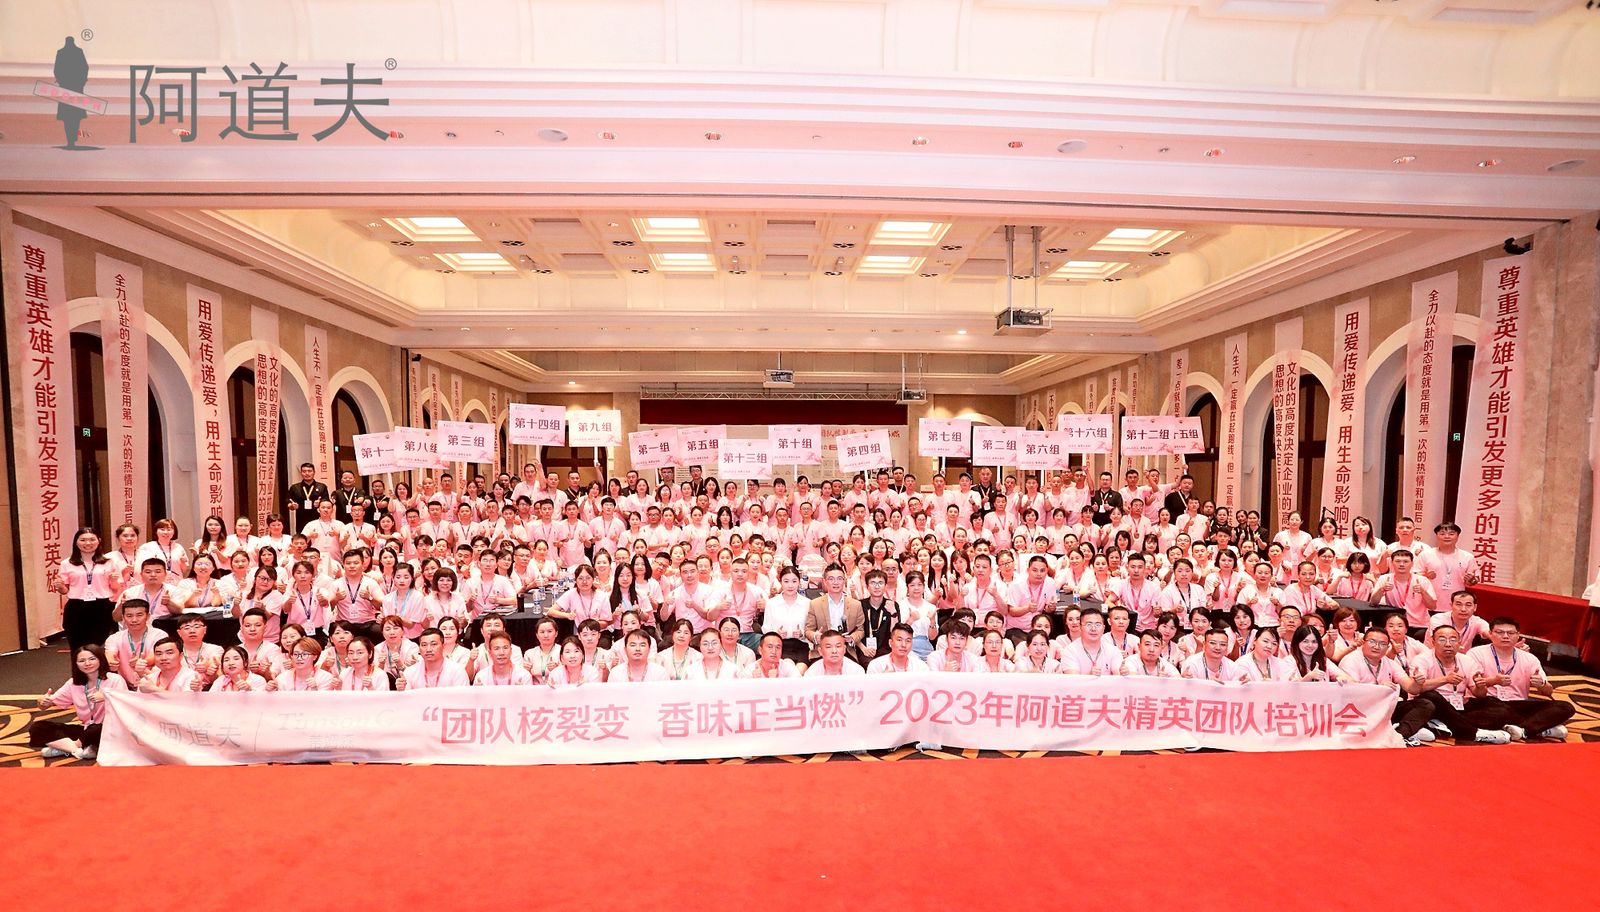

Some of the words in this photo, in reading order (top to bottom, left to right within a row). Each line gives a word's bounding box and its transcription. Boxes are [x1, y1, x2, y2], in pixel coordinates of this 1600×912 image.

[1414, 289, 1439, 541] 全力以赴的态度就是用第一次的热情和最后一
[514, 417, 560, 431] 第十四组
[578, 422, 612, 433] 第九组
[447, 434, 485, 447] 第三组
[928, 431, 962, 442] 第七组
[1126, 429, 1170, 440] 第十二组
[638, 441, 670, 455] 第一组
[687, 439, 718, 452] 第五组
[778, 438, 812, 449] 第十组
[847, 443, 881, 457] 第四组
[982, 440, 1016, 451] 第二组
[1026, 444, 1060, 455] 第六组
[1281, 361, 1297, 530] 文化的高度决定企业的高
[723, 453, 767, 464] 第十三组
[880, 689, 1367, 738] 2023年阿道夫精英团队培训会
[158, 720, 242, 749] 阿道夫
